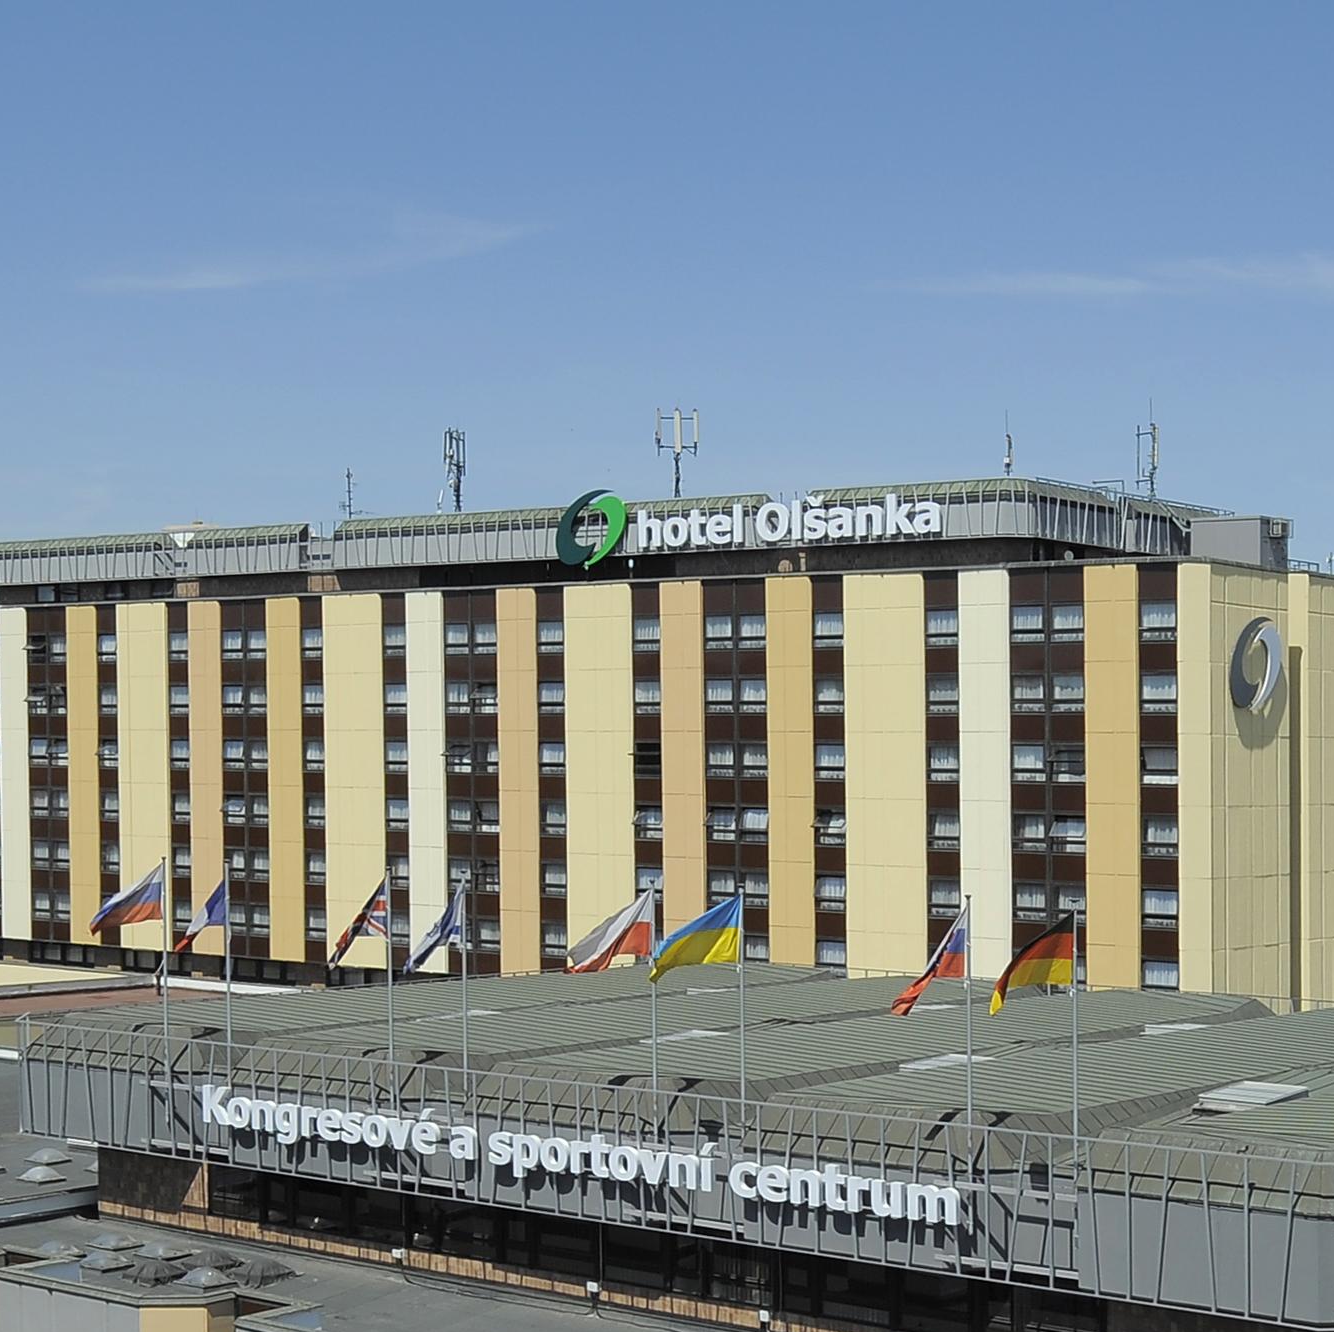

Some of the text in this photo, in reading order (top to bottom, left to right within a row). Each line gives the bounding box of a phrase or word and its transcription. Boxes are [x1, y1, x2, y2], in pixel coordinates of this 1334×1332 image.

[637, 493, 942, 548] hotel Olšanka
[201, 1084, 961, 1226] Kongresové a sportovní centrum
